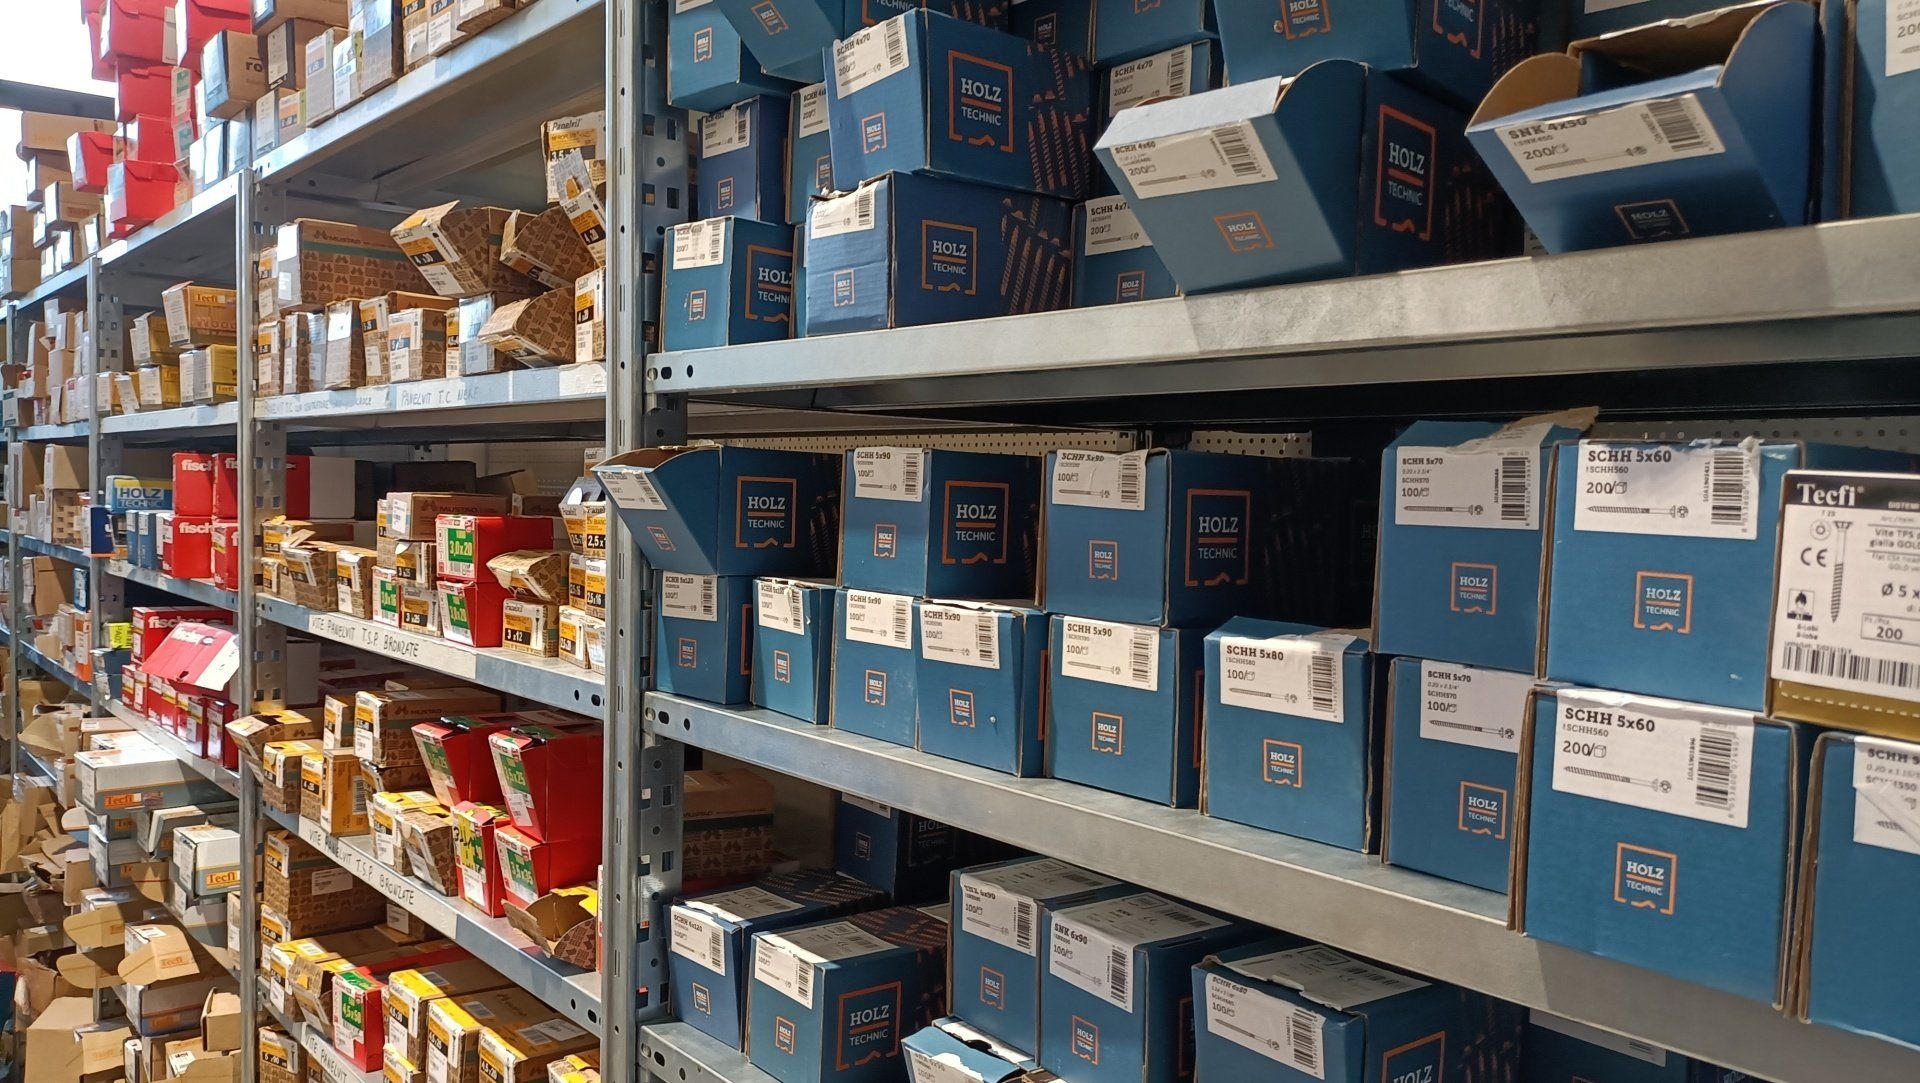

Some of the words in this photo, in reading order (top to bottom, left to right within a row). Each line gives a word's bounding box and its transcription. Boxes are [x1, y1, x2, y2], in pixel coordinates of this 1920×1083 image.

[961, 77, 1001, 102] HOLZ
[961, 107, 1001, 126] TECHNIC
[1508, 123, 1545, 140] SNK
[1389, 142, 1425, 175] HOLZ
[1387, 180, 1424, 207] TECHNIC
[1227, 222, 1257, 233] HOLZ
[932, 240, 968, 256] HOLZ
[932, 262, 968, 276] TECHNIC
[1426, 457, 1444, 466] 5x70
[1588, 450, 1632, 464] SCHH
[1636, 451, 1672, 464] 5x60
[119, 488, 161, 500] HOLZ
[747, 496, 785, 511] HOLZ
[955, 503, 997, 520] HOLZ
[747, 518, 785, 530] TECHNIC
[1197, 516, 1239, 534] HOLZ
[955, 529, 997, 542] TECHNIC
[1094, 550, 1113, 560] HOLZ
[1197, 546, 1238, 560] TECHNIC
[1459, 575, 1488, 589] HOLZ
[849, 593, 868, 605] SCHH
[1459, 591, 1487, 601] TECHNIC
[1645, 586, 1682, 601] HOLZ
[1897, 585, 1907, 598] 5
[924, 609, 943, 619] SCHH
[944, 611, 962, 624] 5x90
[1645, 605, 1681, 617] TECHNIC
[1067, 622, 1091, 634] SCHH
[1093, 624, 1113, 637] 5x90
[1875, 626, 1903, 640] 200
[383, 632, 419, 658] BRONZATE
[1226, 645, 1257, 658] SCHH
[1259, 649, 1284, 662] 5x80
[1427, 670, 1451, 682] SCHH
[1453, 674, 1472, 683] 5x70
[1564, 707, 1613, 727] SCHH
[1617, 715, 1656, 732] 5x60
[1097, 723, 1117, 733] HOLZ
[1270, 750, 1295, 764] HOLZ
[1867, 747, 1907, 763] SCHH
[1468, 795, 1498, 810] HOLZ
[1468, 812, 1497, 824] TECHNIC
[1626, 860, 1665, 880] HOLZ
[1626, 880, 1663, 896] TECHNIC
[1055, 922, 1070, 937] SNK
[1070, 931, 1088, 945] 6x90
[849, 1004, 890, 1027] HOLZ
[849, 1030, 889, 1047] TECHNIC
